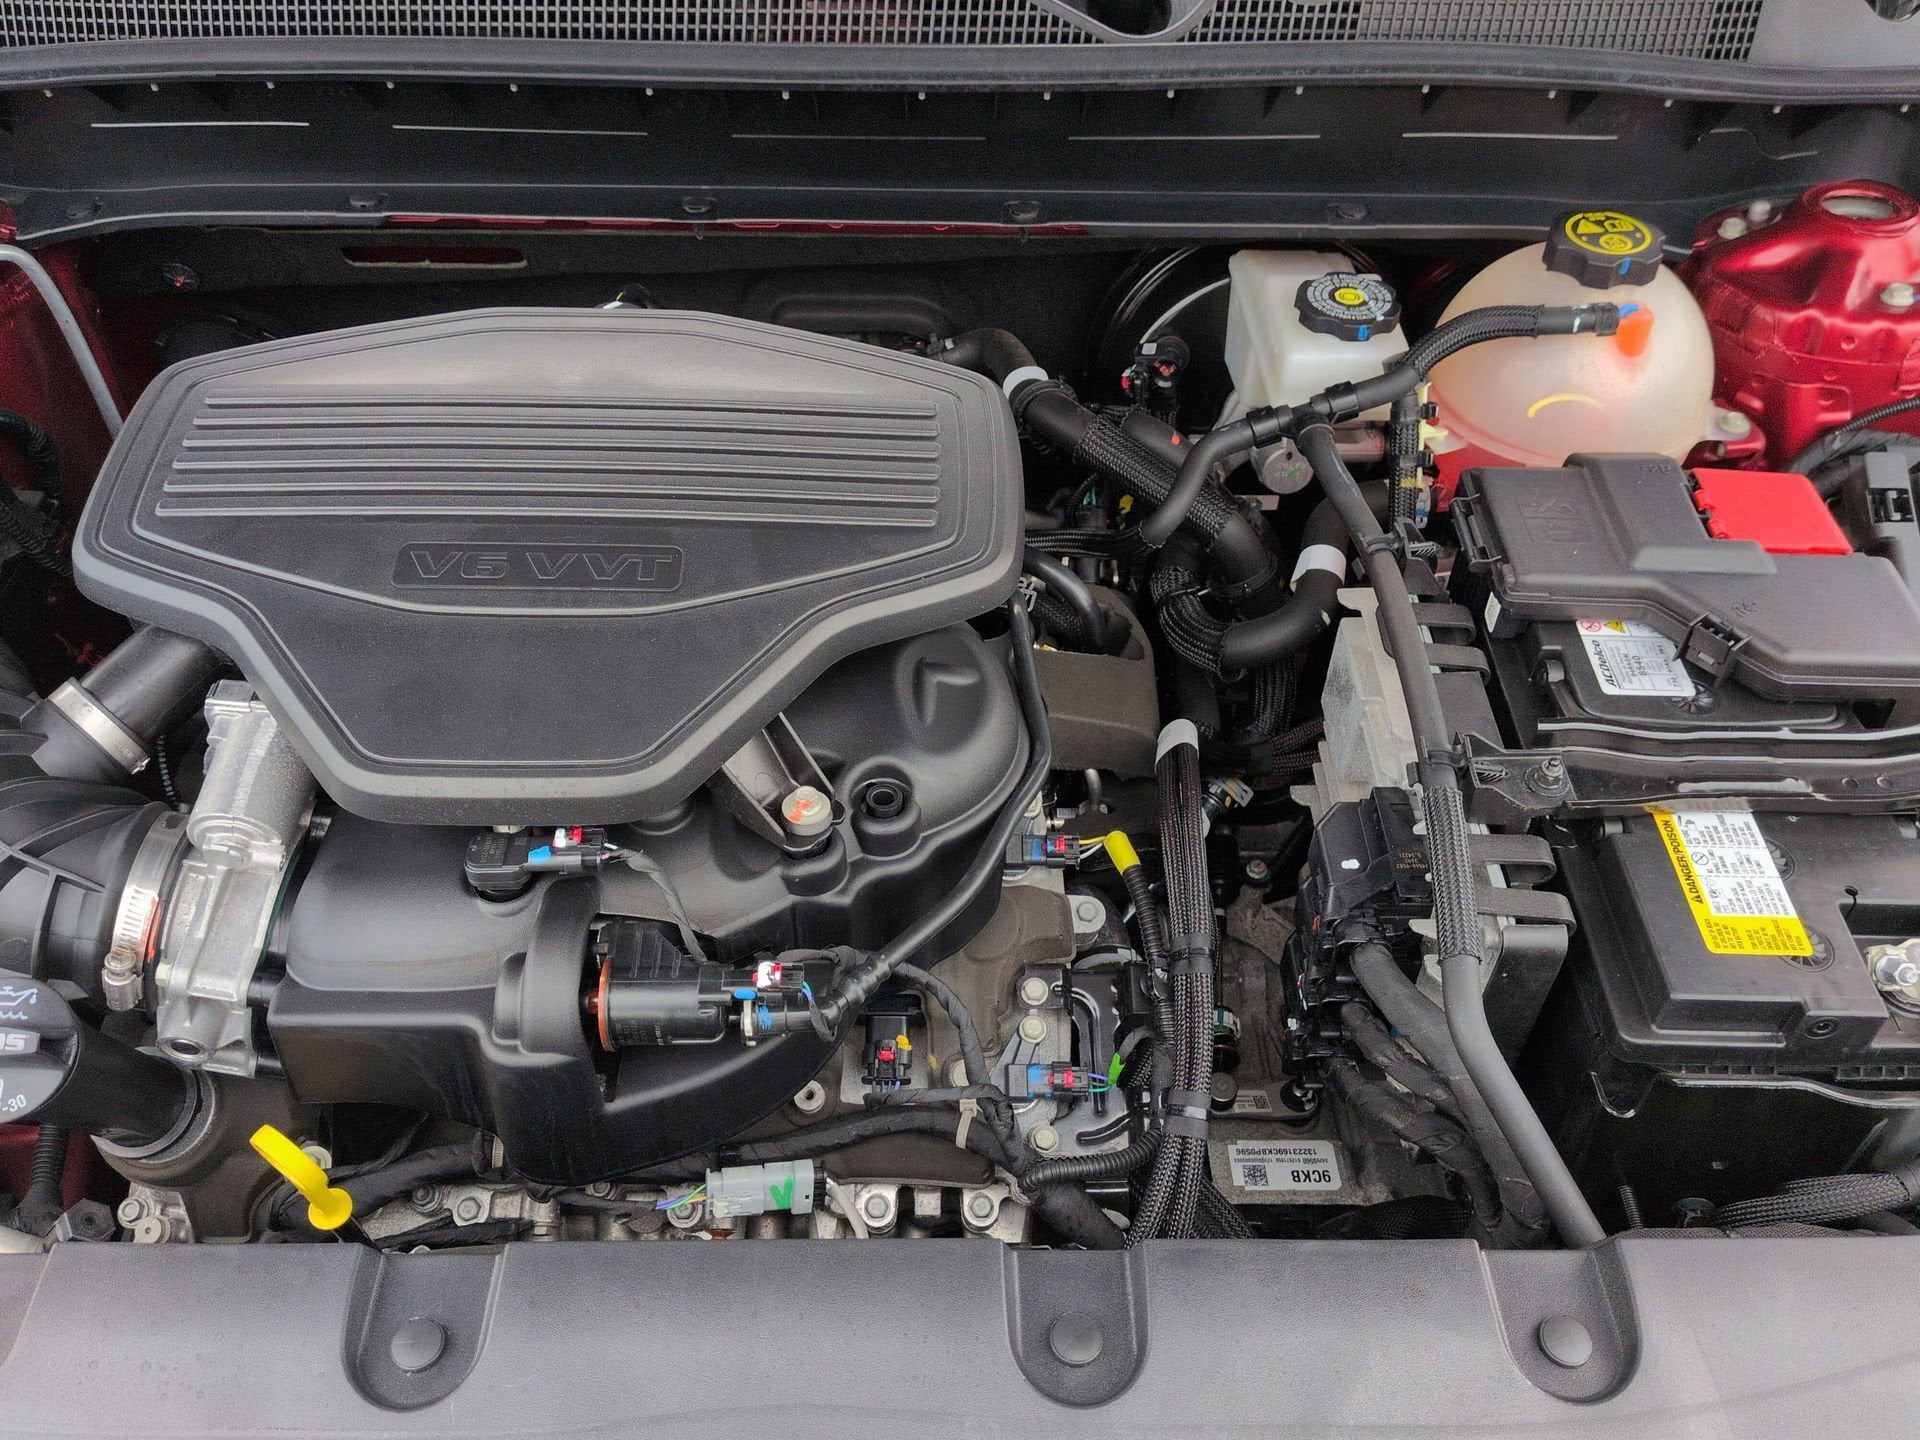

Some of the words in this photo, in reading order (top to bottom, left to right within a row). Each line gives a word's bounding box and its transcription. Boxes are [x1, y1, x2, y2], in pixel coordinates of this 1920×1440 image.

[409, 551, 508, 578] V6
[526, 551, 673, 580] VVT
[1591, 639, 1617, 688] ACDelco
[1661, 819, 1699, 898] DANGER/POISON
[1291, 1169, 1332, 1183] 9CKB
